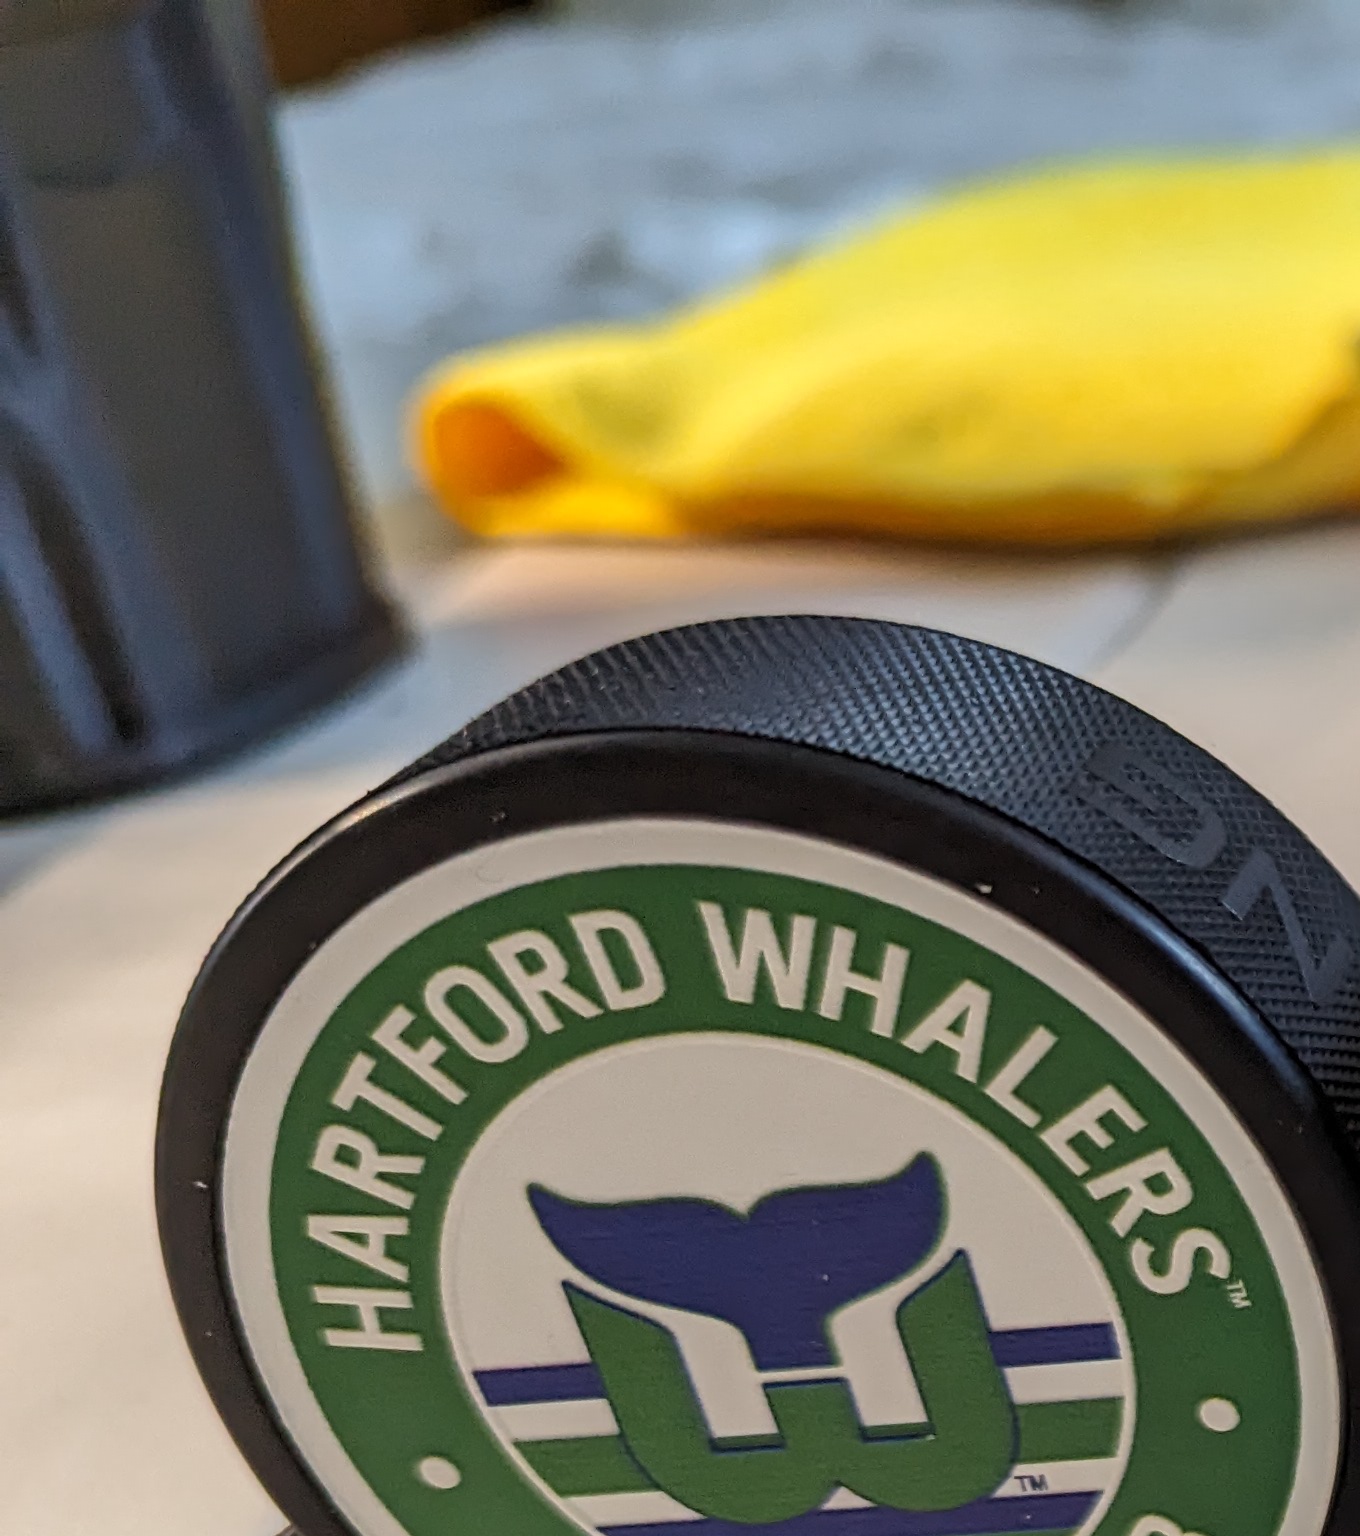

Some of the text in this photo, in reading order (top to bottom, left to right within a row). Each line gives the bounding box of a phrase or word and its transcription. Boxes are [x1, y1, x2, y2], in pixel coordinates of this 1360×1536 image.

[306, 907, 667, 1353] HARTFORD
[697, 900, 1231, 1297] WHALERS
[1013, 1473, 1049, 1493] TM
